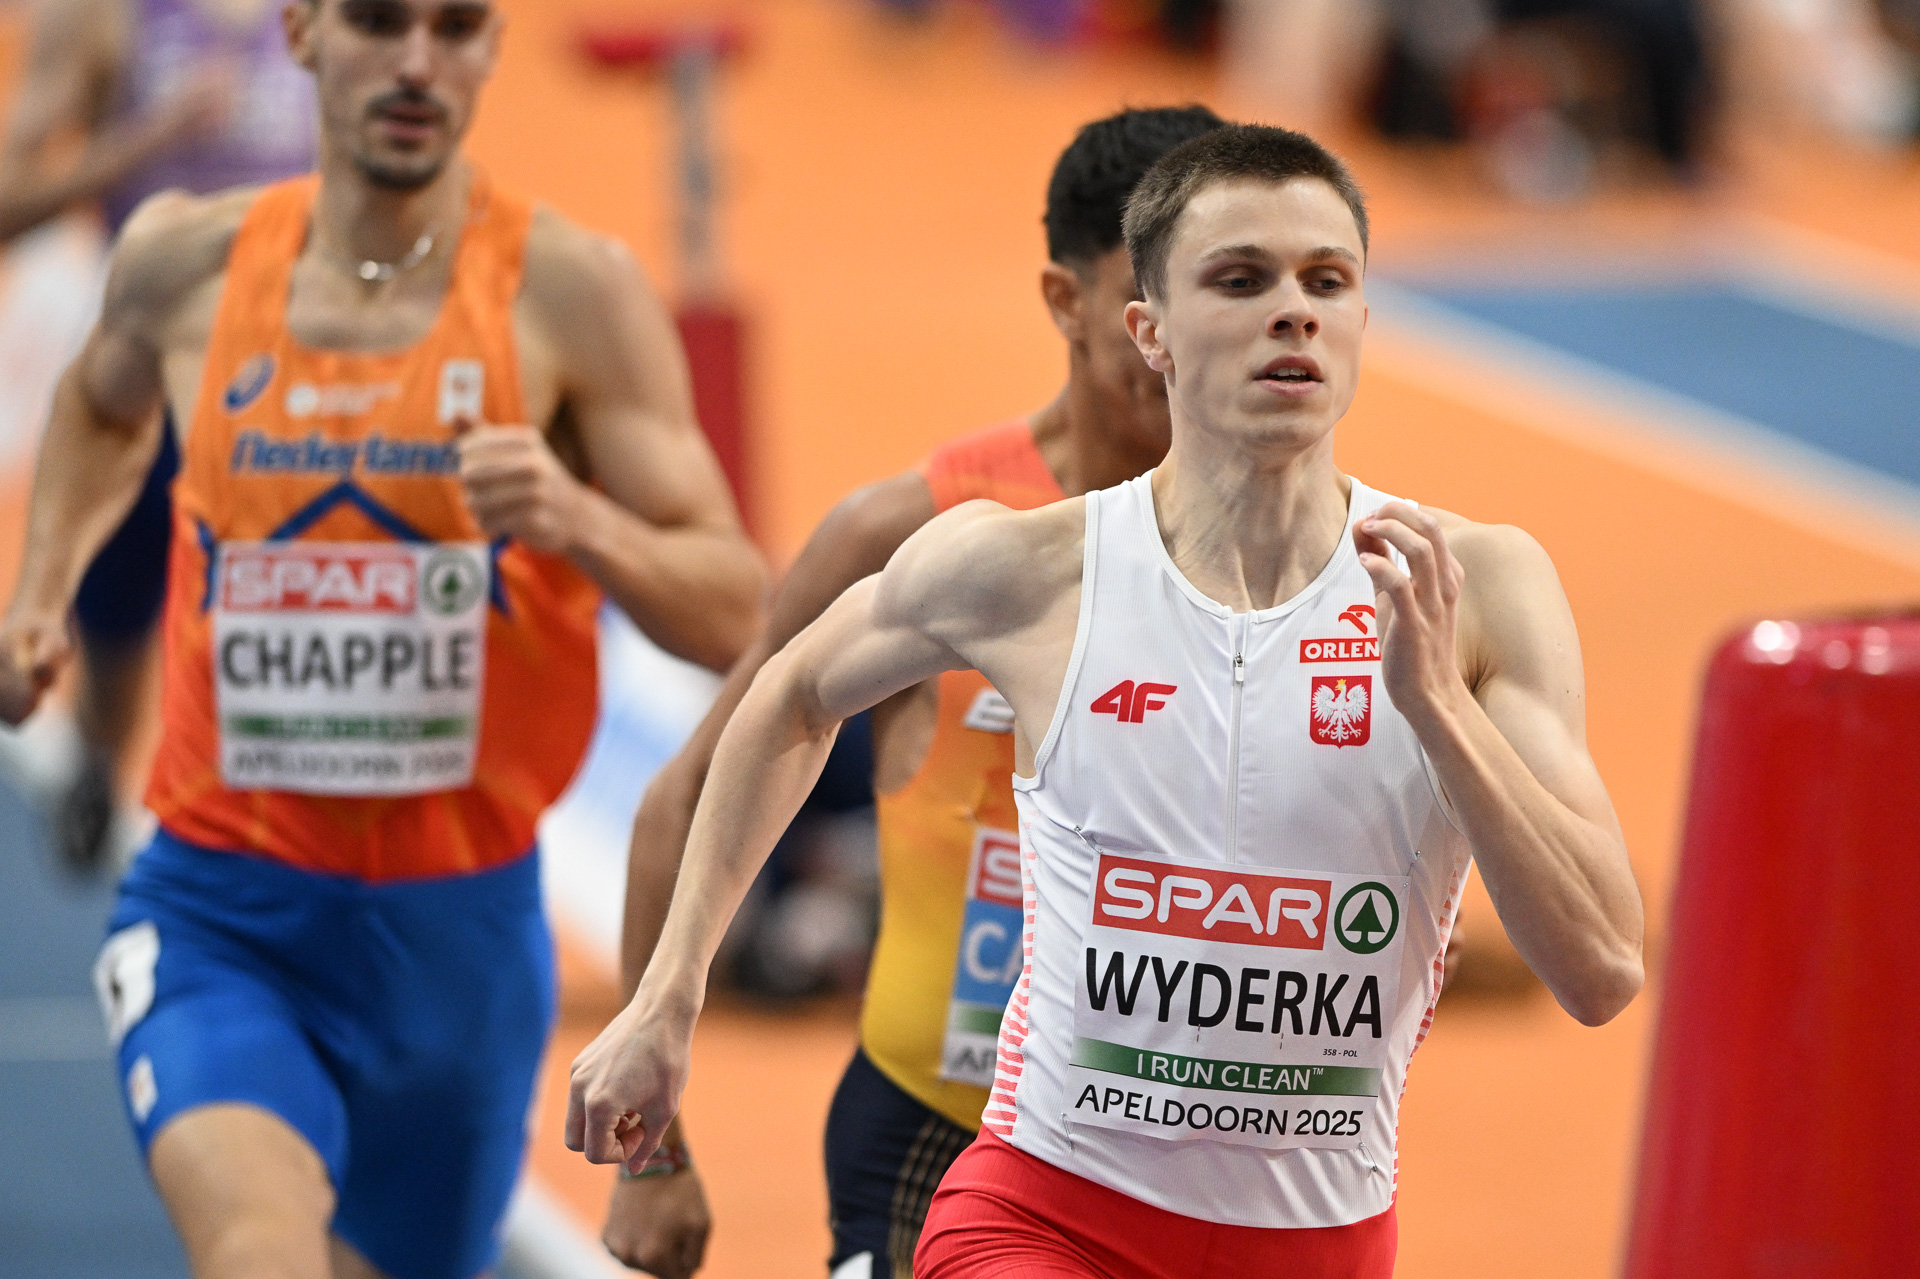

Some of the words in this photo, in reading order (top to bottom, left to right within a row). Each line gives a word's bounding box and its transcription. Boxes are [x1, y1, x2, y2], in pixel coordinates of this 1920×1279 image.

[226, 558, 411, 603] SPAR
[221, 630, 474, 691] CHAPPLE
[1304, 642, 1380, 660] ORLEN
[1090, 679, 1178, 724] 4F
[1101, 867, 1323, 939] SPAR
[1085, 947, 1382, 1039] WYDERKA
[1137, 1053, 1144, 1075] I
[1151, 1055, 1214, 1085] RUN
[1322, 1049, 1337, 1057] 358
[1343, 1050, 1358, 1058] POL
[1074, 1084, 1289, 1136] APELDOORN
[1294, 1109, 1364, 1137] 2025
